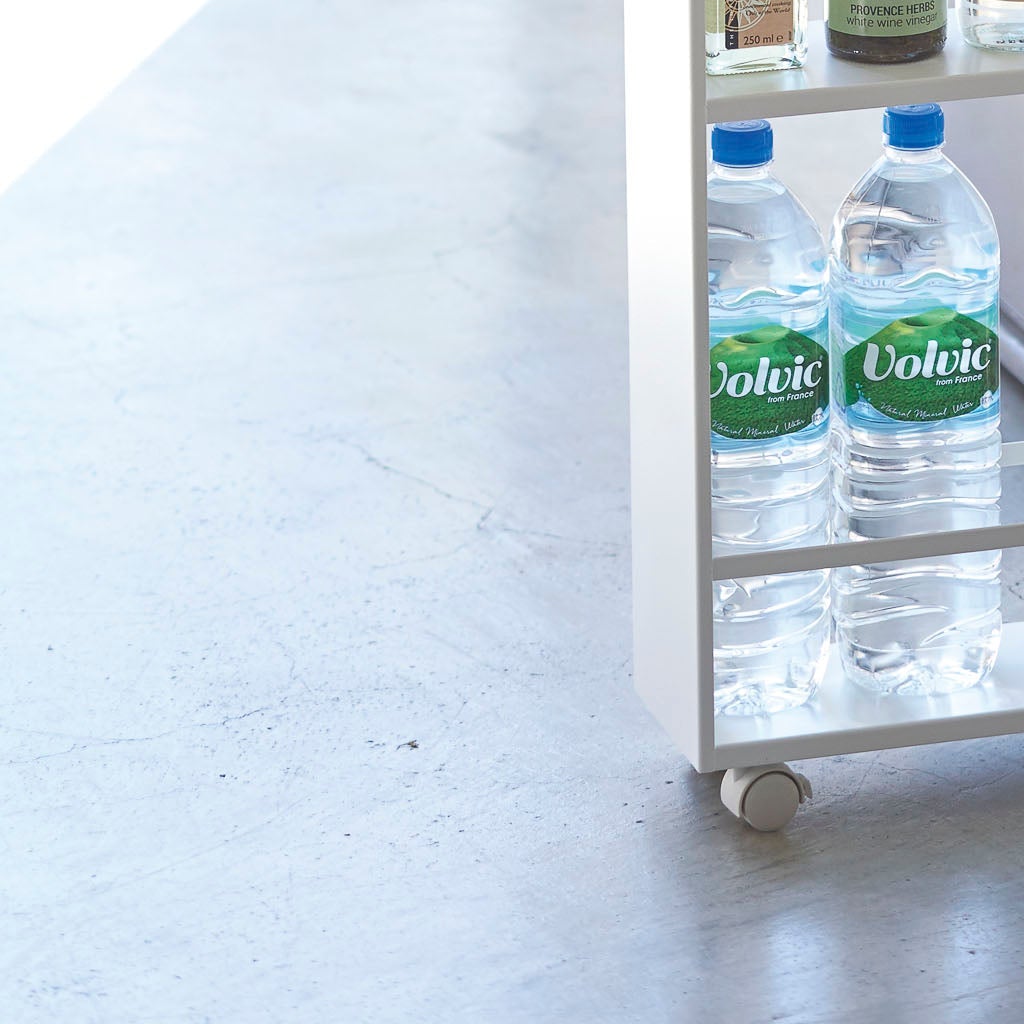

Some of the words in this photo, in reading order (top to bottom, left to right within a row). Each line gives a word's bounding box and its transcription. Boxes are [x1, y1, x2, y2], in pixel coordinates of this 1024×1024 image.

[850, 4, 904, 16] PROVENCE
[906, 0, 935, 15] HERBS
[846, 15, 874, 27] white
[877, 17, 903, 27] wine
[905, 12, 938, 26] vinegar
[743, 36, 760, 46] 250
[763, 34, 774, 44] ml
[863, 338, 992, 382] Volvic
[936, 378, 953, 386] from
[955, 374, 983, 384] France
[786, 391, 814, 401] France
[880, 401, 911, 418] Natural
[914, 408, 948, 420] Mineral
[952, 401, 974, 414] Water
[712, 419, 742, 436] Natural
[745, 425, 779, 437] Mineral
[783, 418, 806, 431] Water
